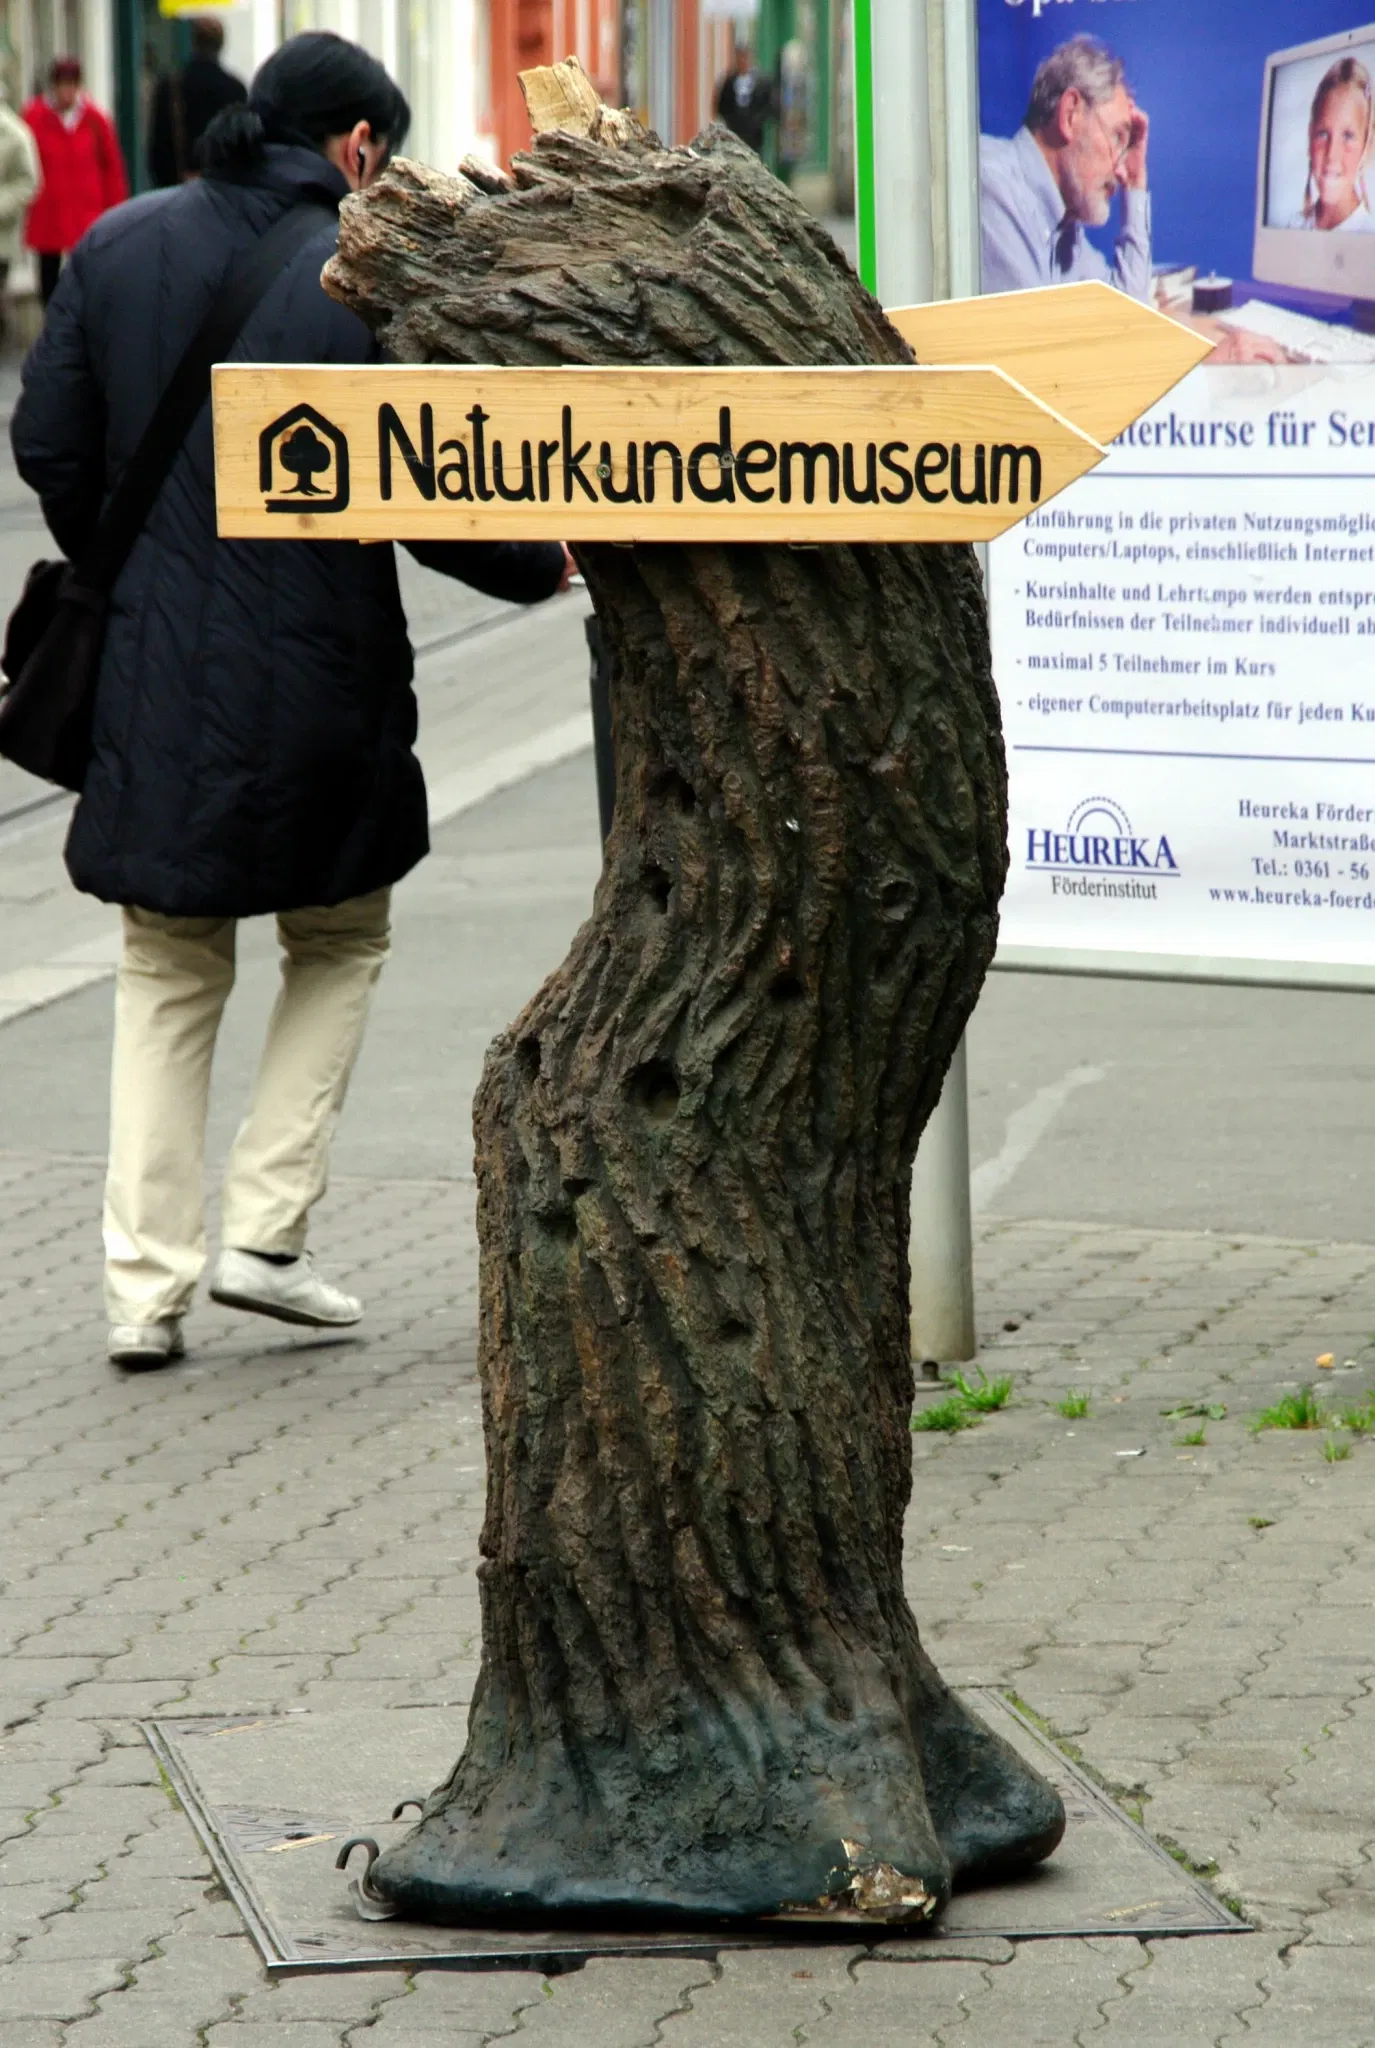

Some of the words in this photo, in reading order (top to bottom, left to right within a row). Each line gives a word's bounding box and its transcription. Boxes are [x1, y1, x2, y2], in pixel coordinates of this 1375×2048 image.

[1266, 411, 1317, 448] für
[379, 402, 1042, 505] Naturkundemuseum
[1025, 509, 1113, 534] Einführung
[1118, 511, 1134, 531] in
[1139, 512, 1163, 531] die
[1168, 512, 1237, 536] privaten
[1023, 538, 1181, 564] Computers/Laptops,
[1185, 541, 1298, 563] einschließlich
[1304, 543, 1375, 562] Internet
[1025, 580, 1117, 601] Kursinhalte
[1121, 583, 1151, 602] und
[1253, 586, 1313, 605] werden
[1318, 588, 1375, 611] entspr
[1025, 608, 1125, 630] Bedürfnissen
[1129, 612, 1156, 631] der
[1161, 612, 1254, 633] Teilnehmer
[1259, 615, 1350, 635] individuell
[1027, 652, 1094, 672] maximal
[1098, 653, 1108, 672] 5
[1112, 654, 1202, 675] Teilnehmer
[1206, 656, 1228, 676] im
[1234, 657, 1277, 677] Kurs
[1028, 692, 1084, 716] eigener
[1088, 694, 1260, 723] Computerarbeitsplatz
[1266, 700, 1293, 721] für
[1297, 702, 1344, 725] jeden
[1238, 799, 1309, 821] Heureka
[1315, 802, 1375, 823] Förder
[1026, 828, 1178, 870] HEUREKA
[1251, 857, 1288, 877] Tel.:
[1293, 859, 1330, 879] 0361
[1349, 861, 1370, 881] 56
[1051, 875, 1158, 900] Förderinstitut
[1208, 885, 1375, 910] www.heureka-foerd
